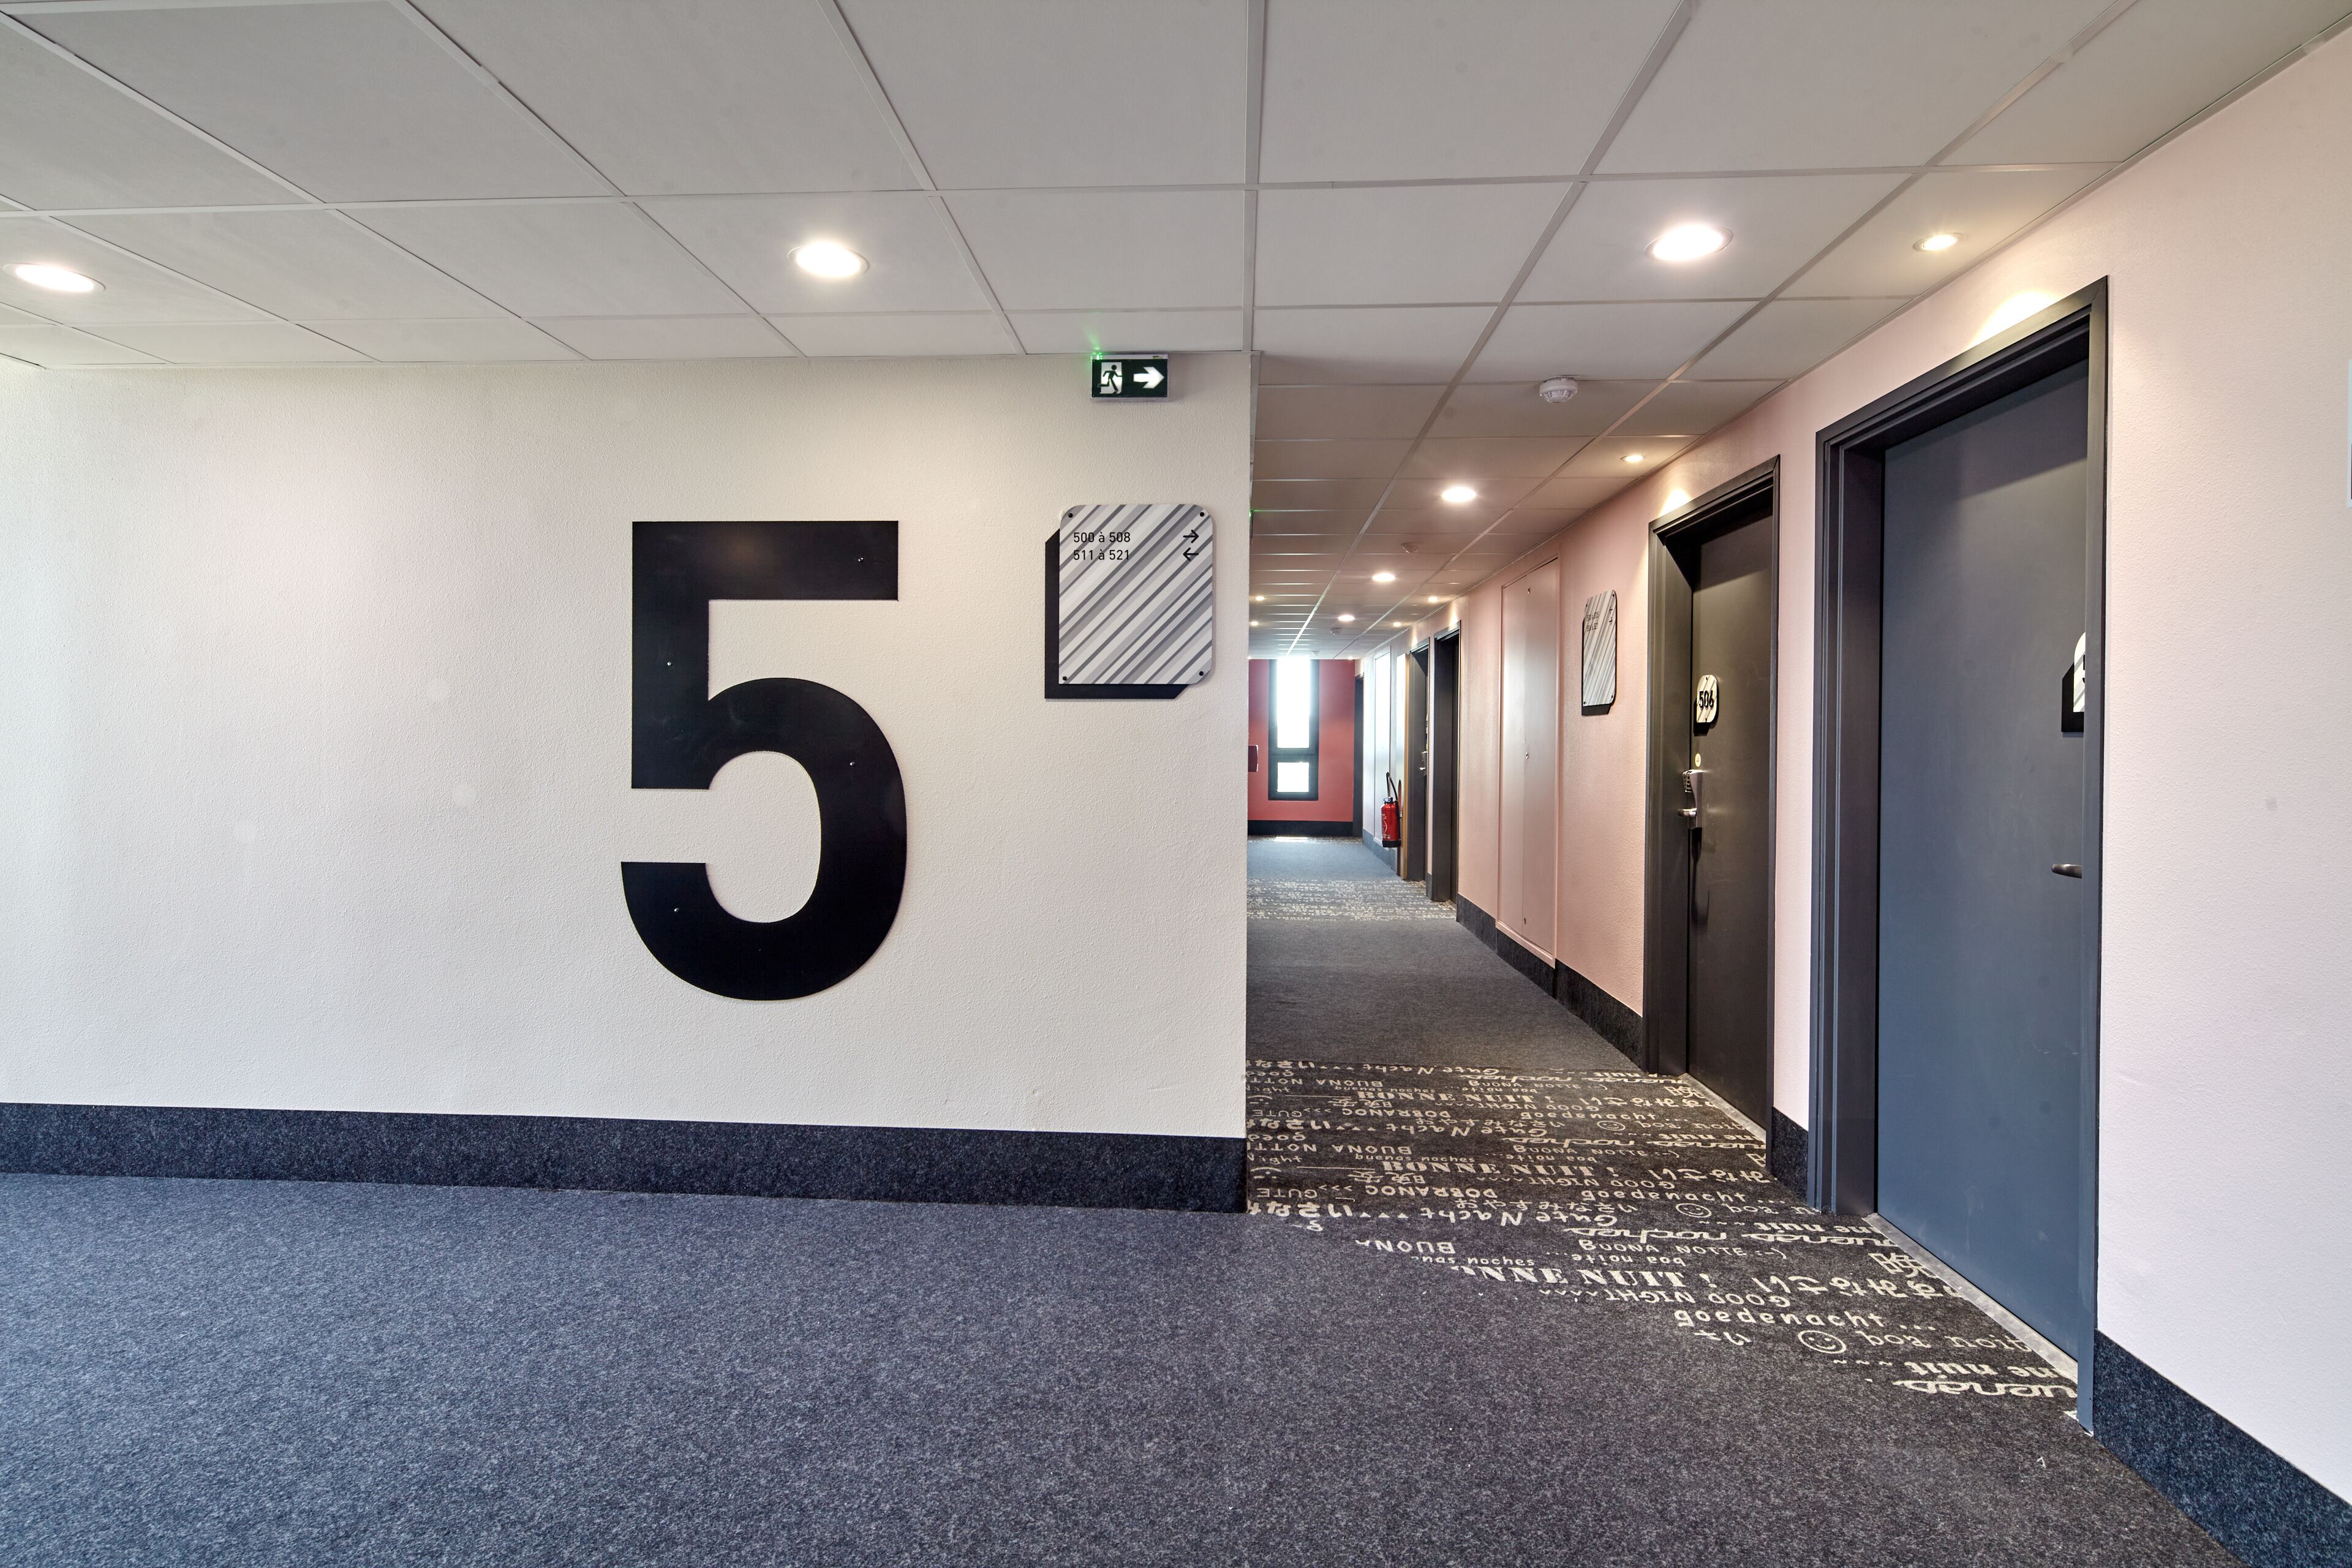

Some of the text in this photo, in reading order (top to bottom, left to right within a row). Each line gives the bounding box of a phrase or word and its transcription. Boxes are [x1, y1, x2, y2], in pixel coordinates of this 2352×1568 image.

[1073, 532, 1131, 543] 500 à 508
[1073, 549, 1129, 560] 511 à 521
[1699, 690, 1714, 708] 506
[622, 521, 907, 1000] 5
[1363, 1064, 1434, 1075] Nacht
[1358, 1091, 1455, 1101] BONNE
[1342, 1109, 1450, 1118] DOBRANOC
[1387, 1124, 1547, 1137] Gute Nacht
[1332, 1145, 1412, 1155] BUONA
[1513, 1145, 1577, 1153] BUONA
[1382, 1161, 1500, 1174] BONNE
[1509, 1164, 1594, 1176] NUIT
[1529, 1177, 1675, 1189] GOOD NIGHT
[1257, 1188, 1317, 1200] GUTE
[1366, 1186, 1497, 1198] DOBRANOC
[1581, 1189, 1746, 1202] goedenacht
[1420, 1207, 1617, 1227] Gute Nacht
[1755, 1221, 1823, 1233] nuit
[1578, 1239, 1659, 1252] BUONA
[1675, 1246, 1747, 1256] NOTTE
[1468, 1256, 1534, 1265] noches
[1647, 1257, 1686, 1267] boa
[1577, 1270, 1686, 1287] NUIT
[1604, 1289, 1790, 1307] GOOD NIGHT
[1674, 1308, 1883, 1327] goedenacht
[1855, 1330, 1931, 1348] boa
[1904, 1362, 1997, 1377] nuit
